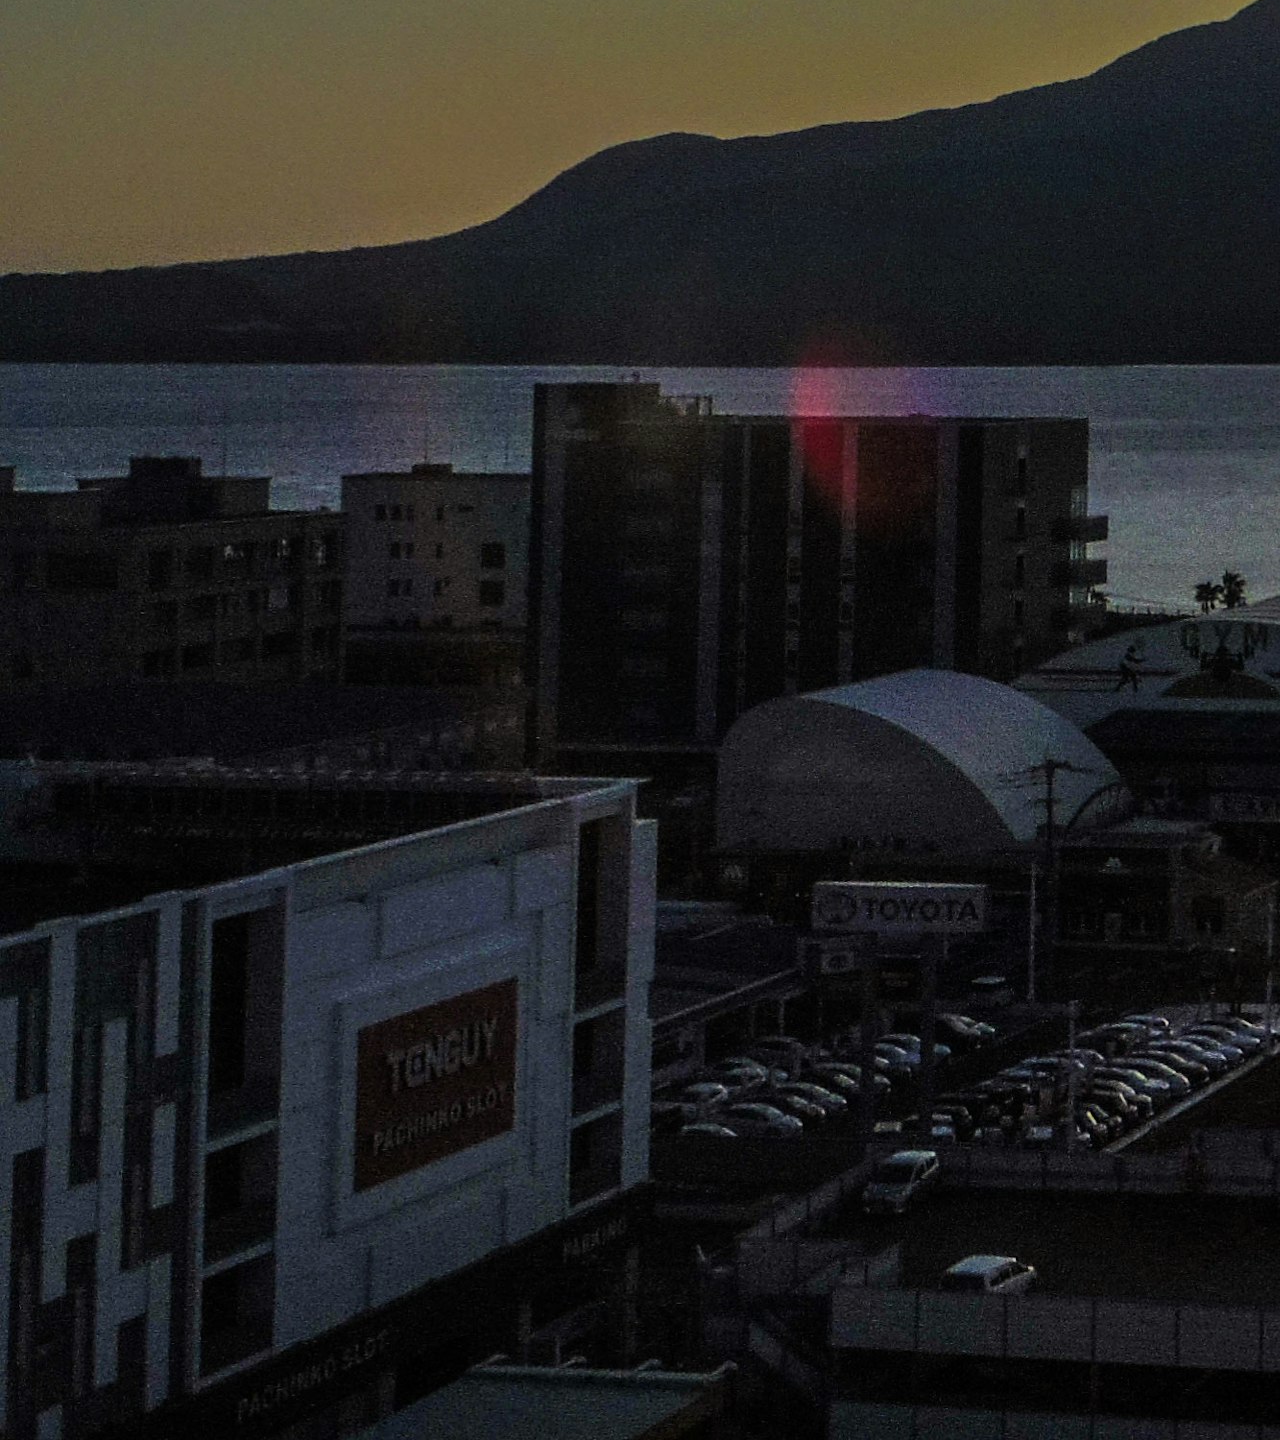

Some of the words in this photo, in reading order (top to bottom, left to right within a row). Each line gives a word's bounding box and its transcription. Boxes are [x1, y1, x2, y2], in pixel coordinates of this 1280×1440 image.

[860, 896, 980, 923] TOYOTA
[386, 1016, 499, 1094] TENGUY
[373, 1096, 463, 1156] PACHINKO
[466, 1080, 511, 1121] SLOT
